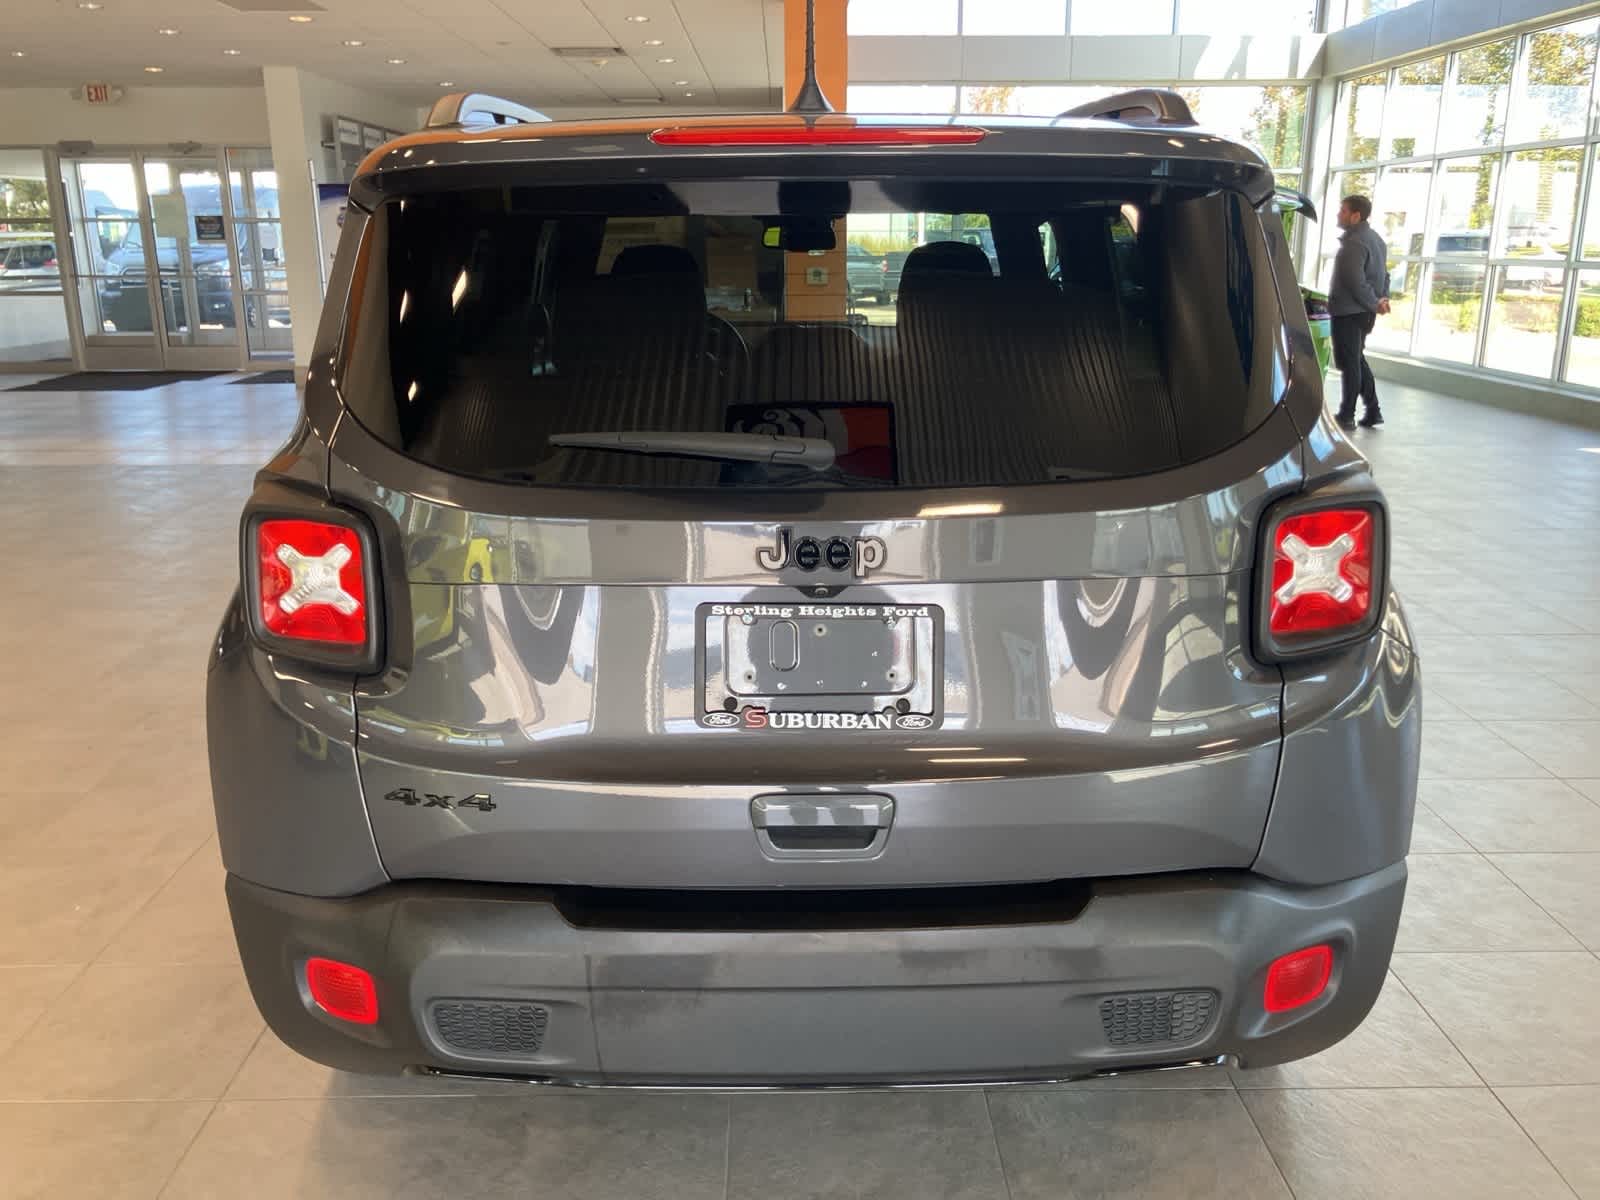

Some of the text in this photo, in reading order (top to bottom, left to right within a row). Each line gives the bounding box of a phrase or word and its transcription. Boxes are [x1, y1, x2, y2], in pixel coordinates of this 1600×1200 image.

[87, 84, 109, 102] EXIT
[756, 526, 888, 577] Jeep
[711, 605, 929, 618] Sterling Heights Ford
[708, 713, 735, 727] Ford
[745, 709, 893, 729] SUBURBAN
[902, 714, 928, 729] Ford
